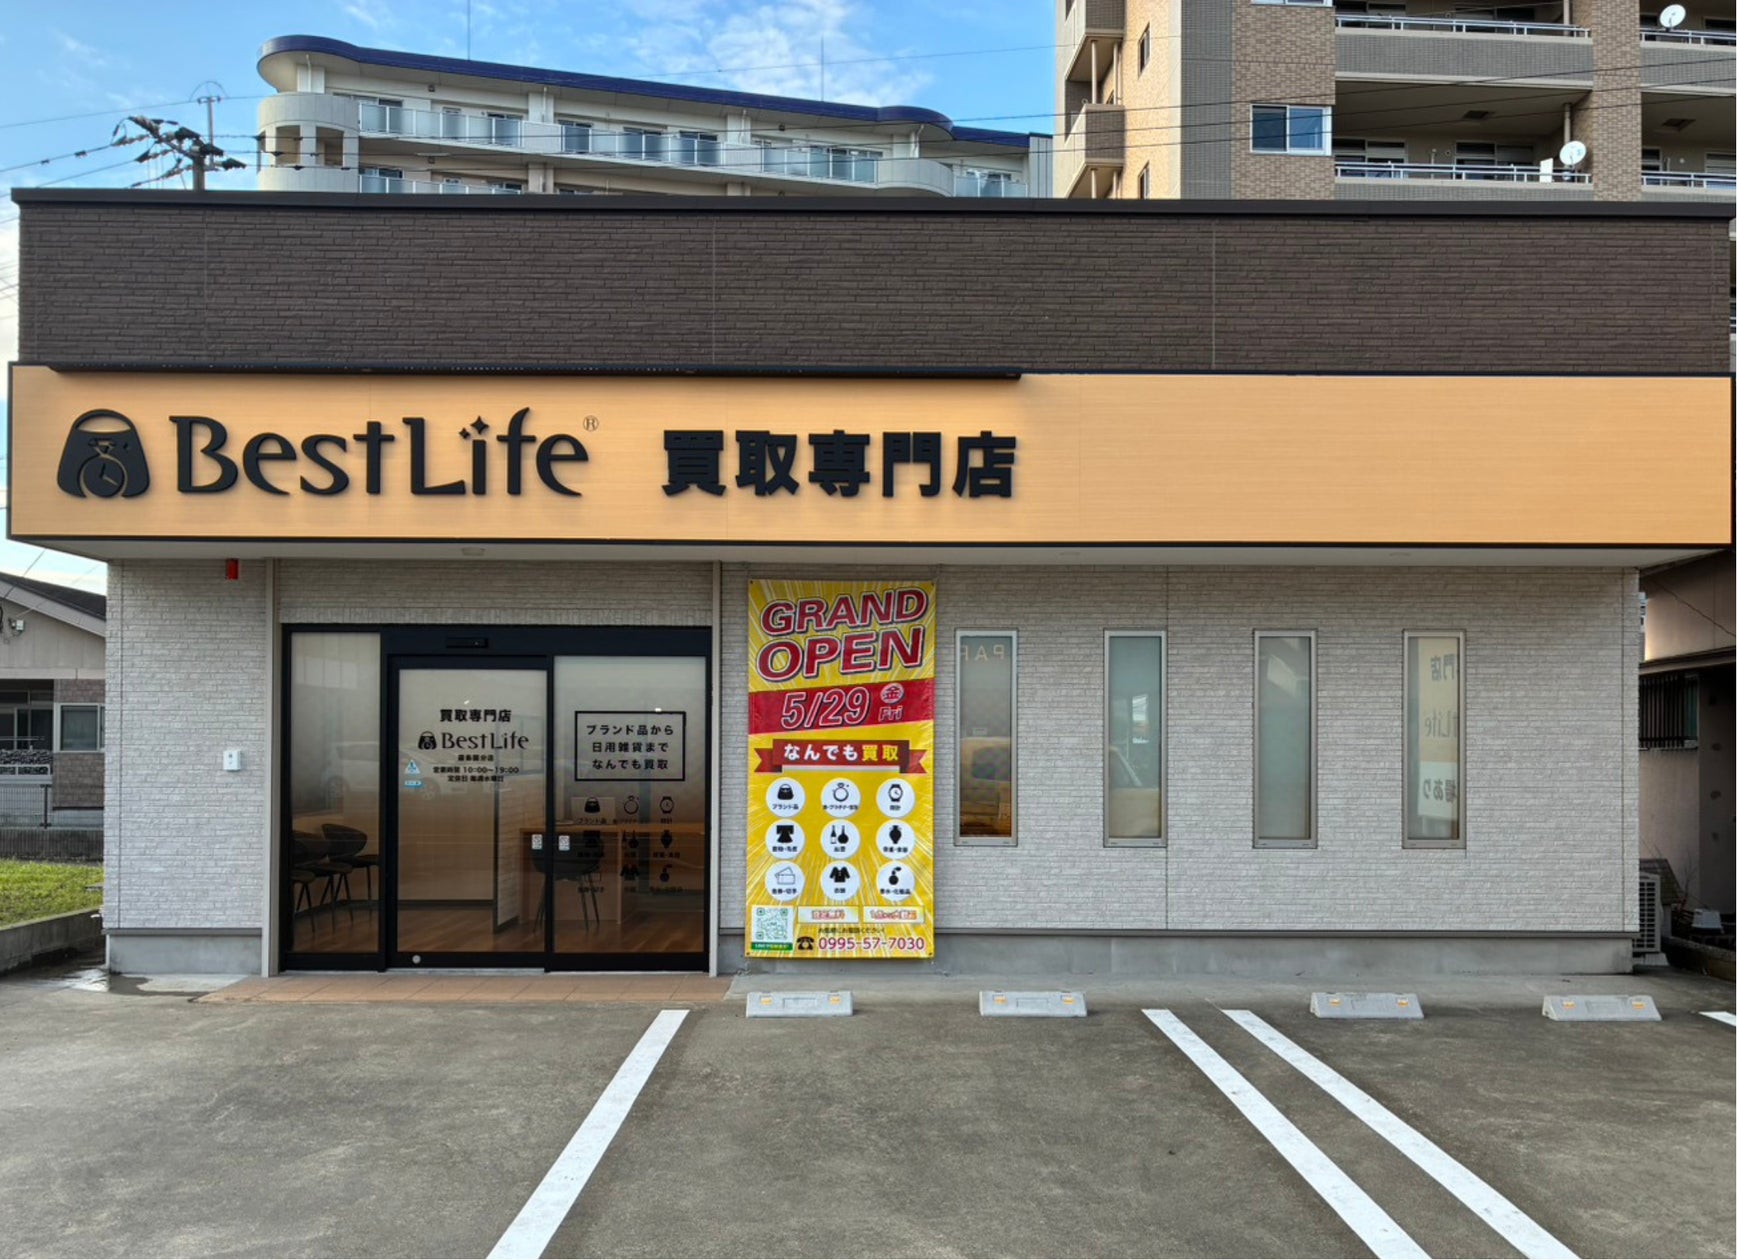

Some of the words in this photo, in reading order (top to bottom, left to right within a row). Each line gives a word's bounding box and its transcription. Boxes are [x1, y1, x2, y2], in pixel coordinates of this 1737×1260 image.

[168, 406, 589, 498] BestLife
[662, 429, 1017, 498] 買取専門店
[760, 587, 929, 637] GRAND
[756, 625, 926, 683] OPEN
[882, 684, 903, 703] 金
[440, 708, 512, 722] 買取専門店
[780, 686, 871, 730] 5/29
[878, 705, 904, 722] Fri
[586, 724, 674, 736] ブランド品から
[441, 731, 529, 749] BestLife
[592, 742, 669, 753] 日用雑貨まで
[783, 743, 899, 762] なんでも買取
[592, 759, 669, 770] なんでも買取
[818, 936, 925, 950] 0995-57-7030
